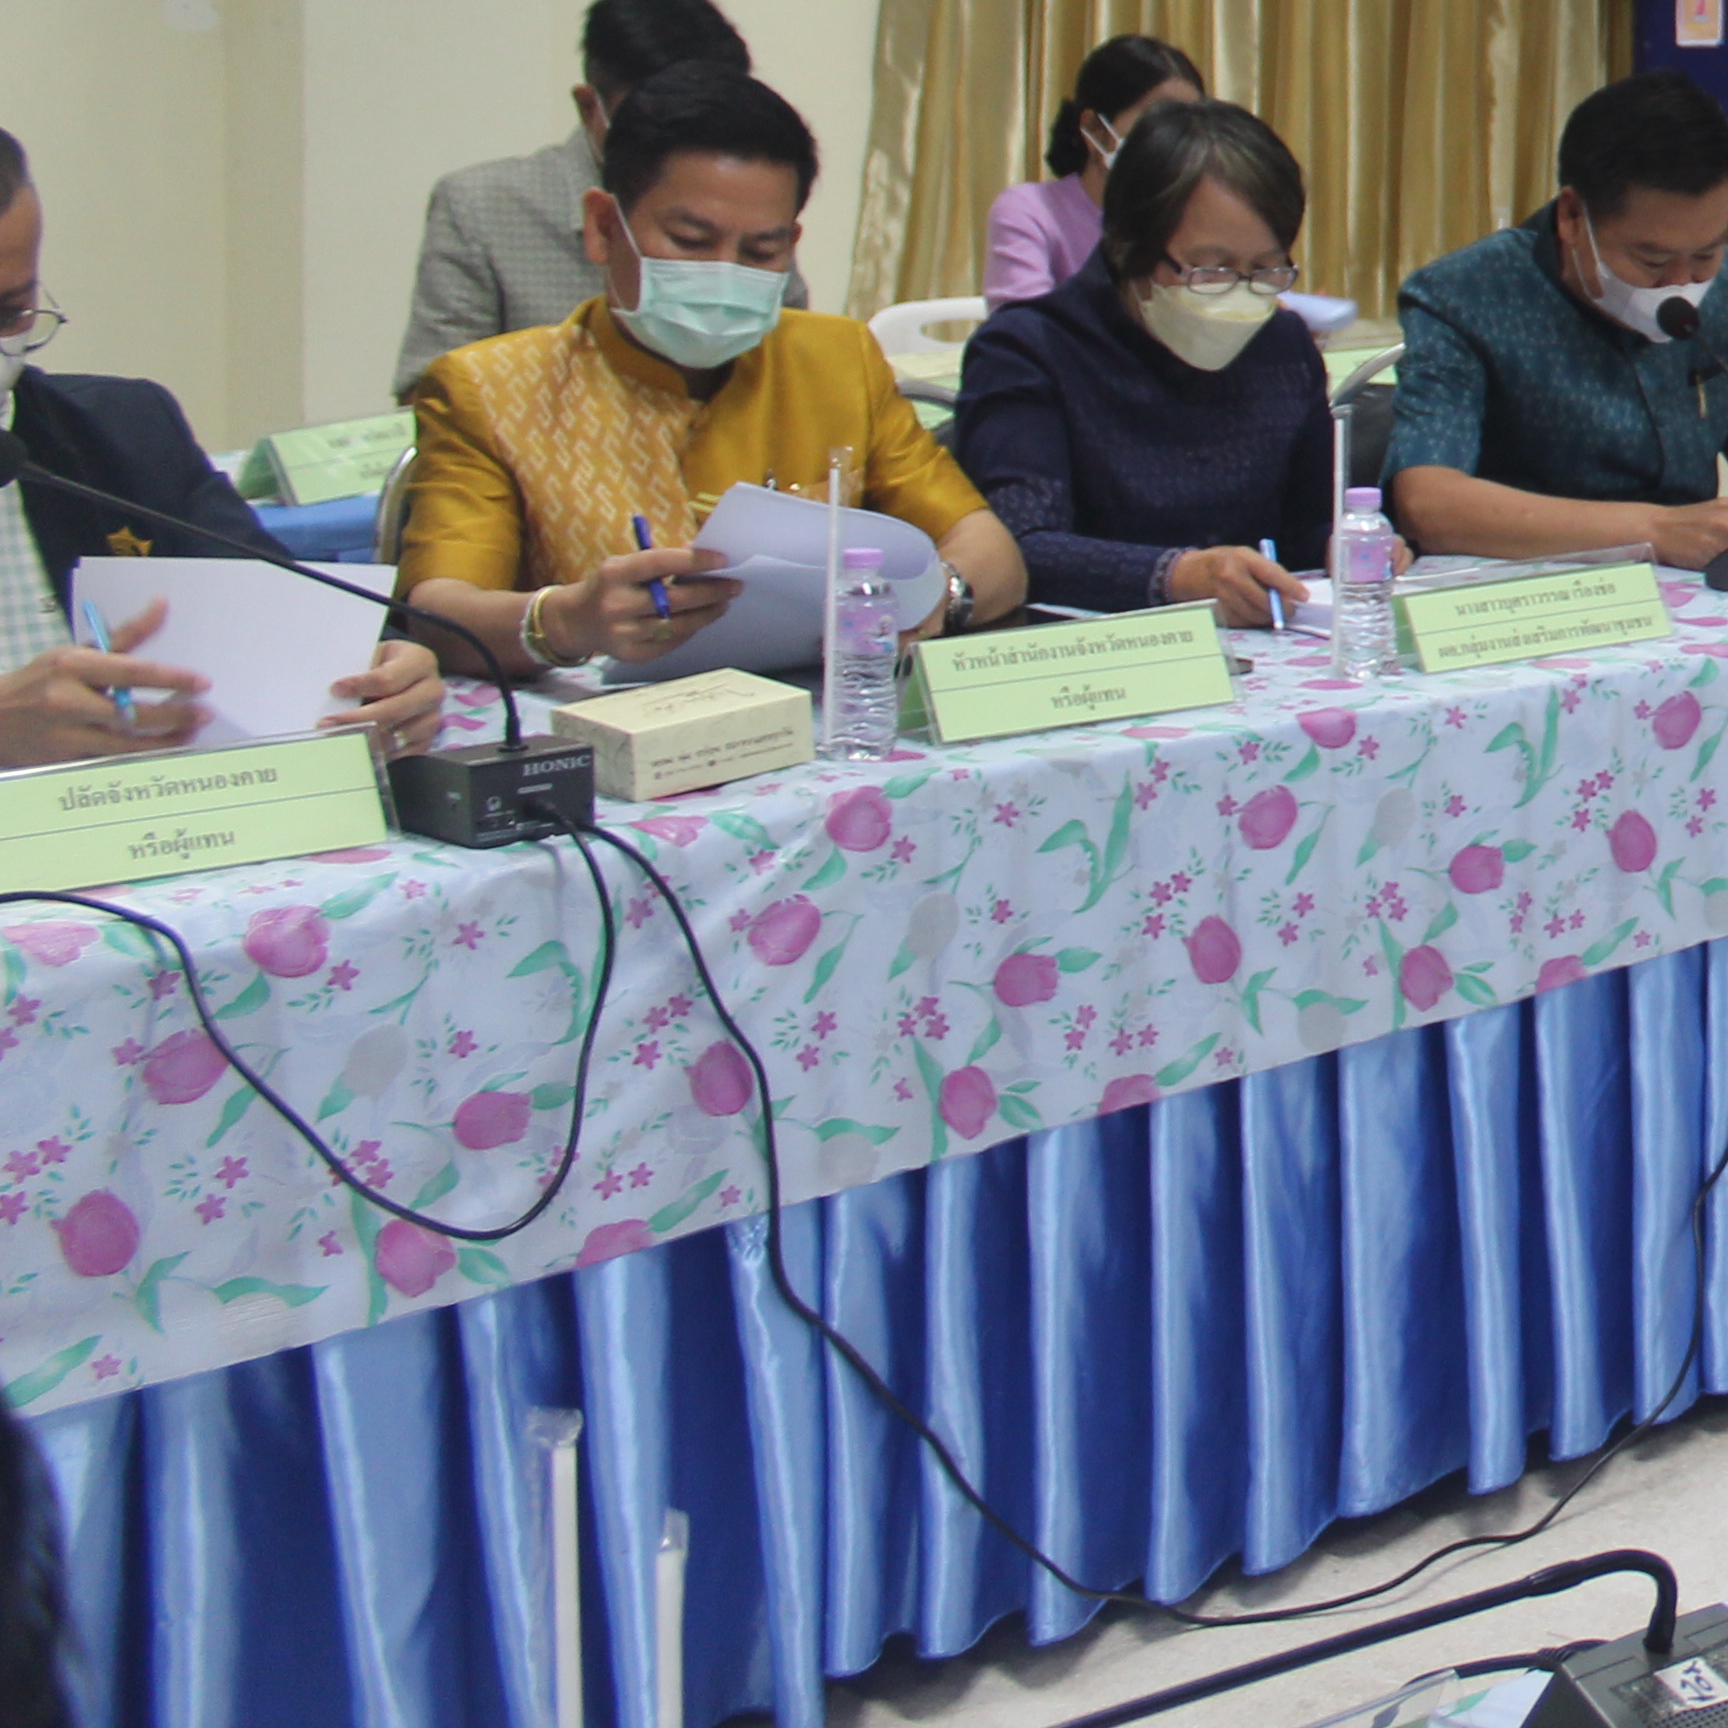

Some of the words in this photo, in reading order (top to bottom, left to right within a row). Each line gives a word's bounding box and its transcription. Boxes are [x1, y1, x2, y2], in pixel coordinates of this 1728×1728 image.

[522, 754, 592, 777] HONIC
[58, 766, 279, 812] ปลัดจังหวัดหนองคาย
[129, 828, 236, 860] หรือผู้แทน
